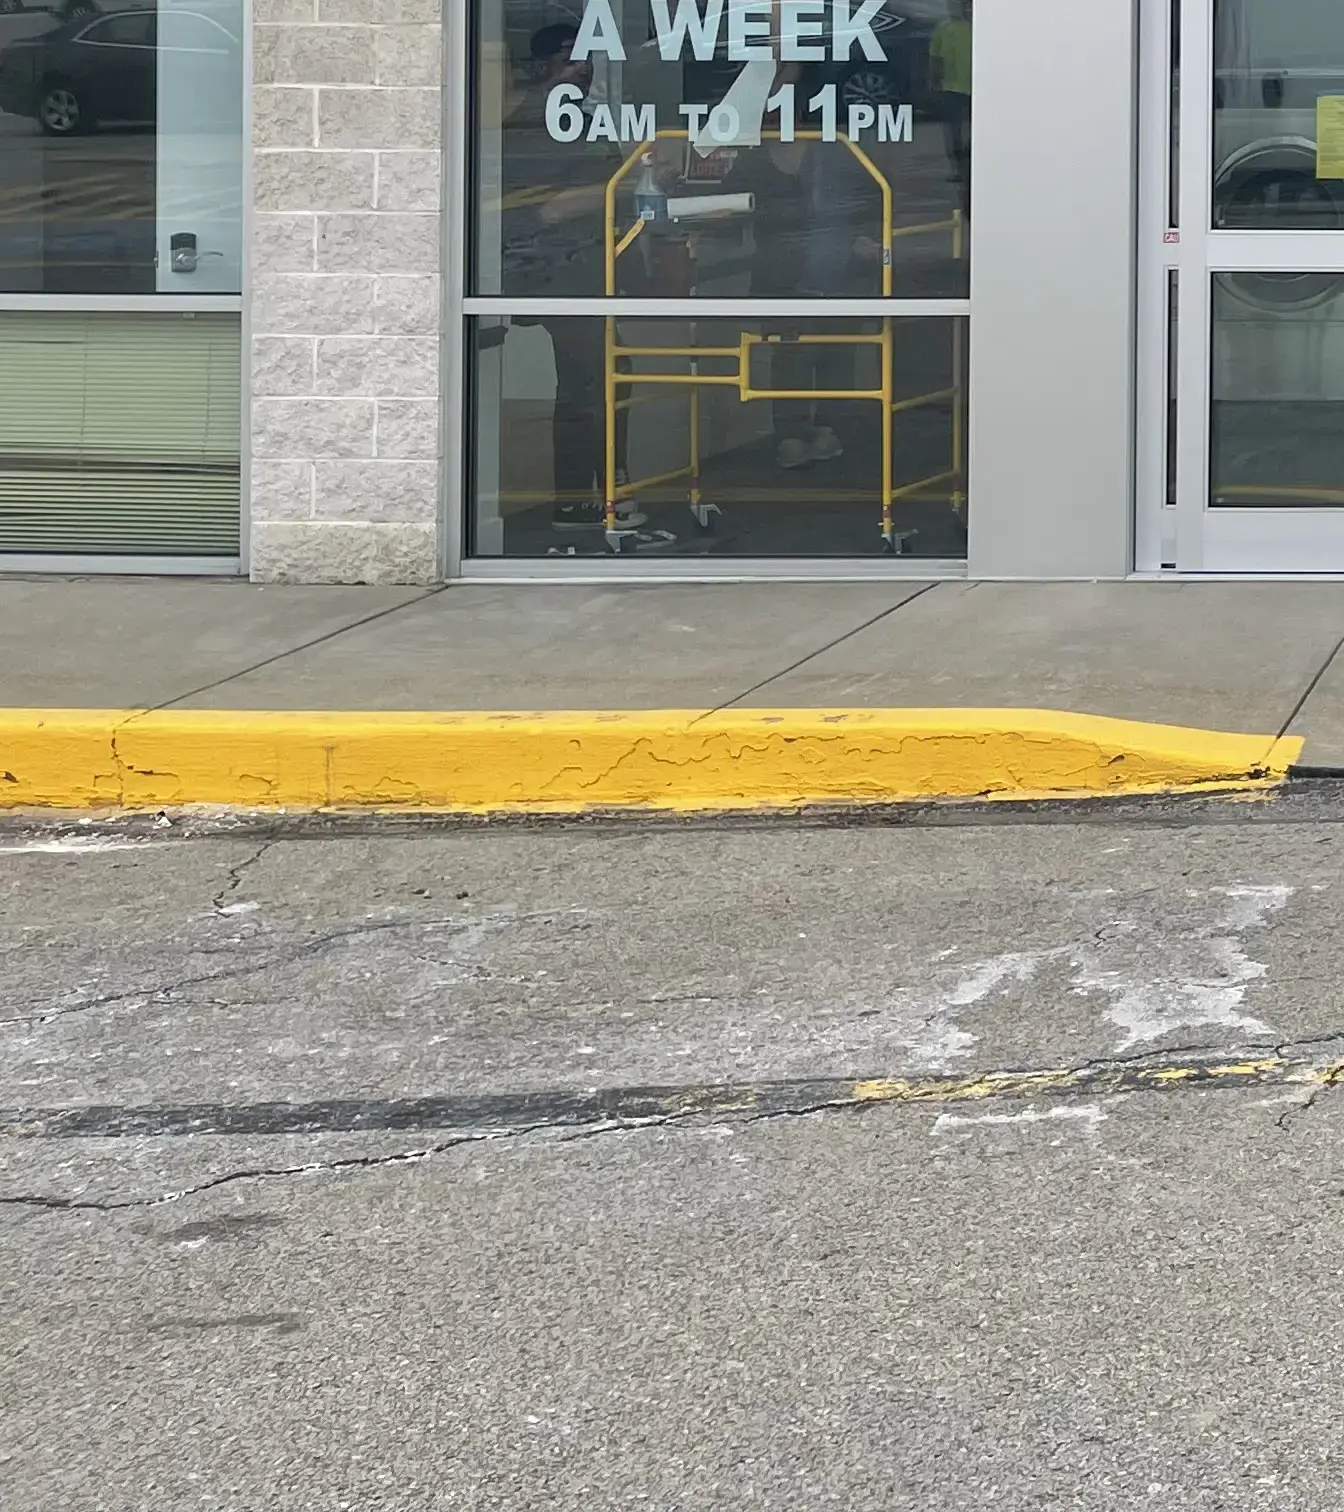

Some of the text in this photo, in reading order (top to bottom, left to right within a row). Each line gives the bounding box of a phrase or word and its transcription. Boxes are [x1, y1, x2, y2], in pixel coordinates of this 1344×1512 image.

[570, 0, 888, 61] A WEEK
[545, 83, 913, 143] 6AM TO 11PM
